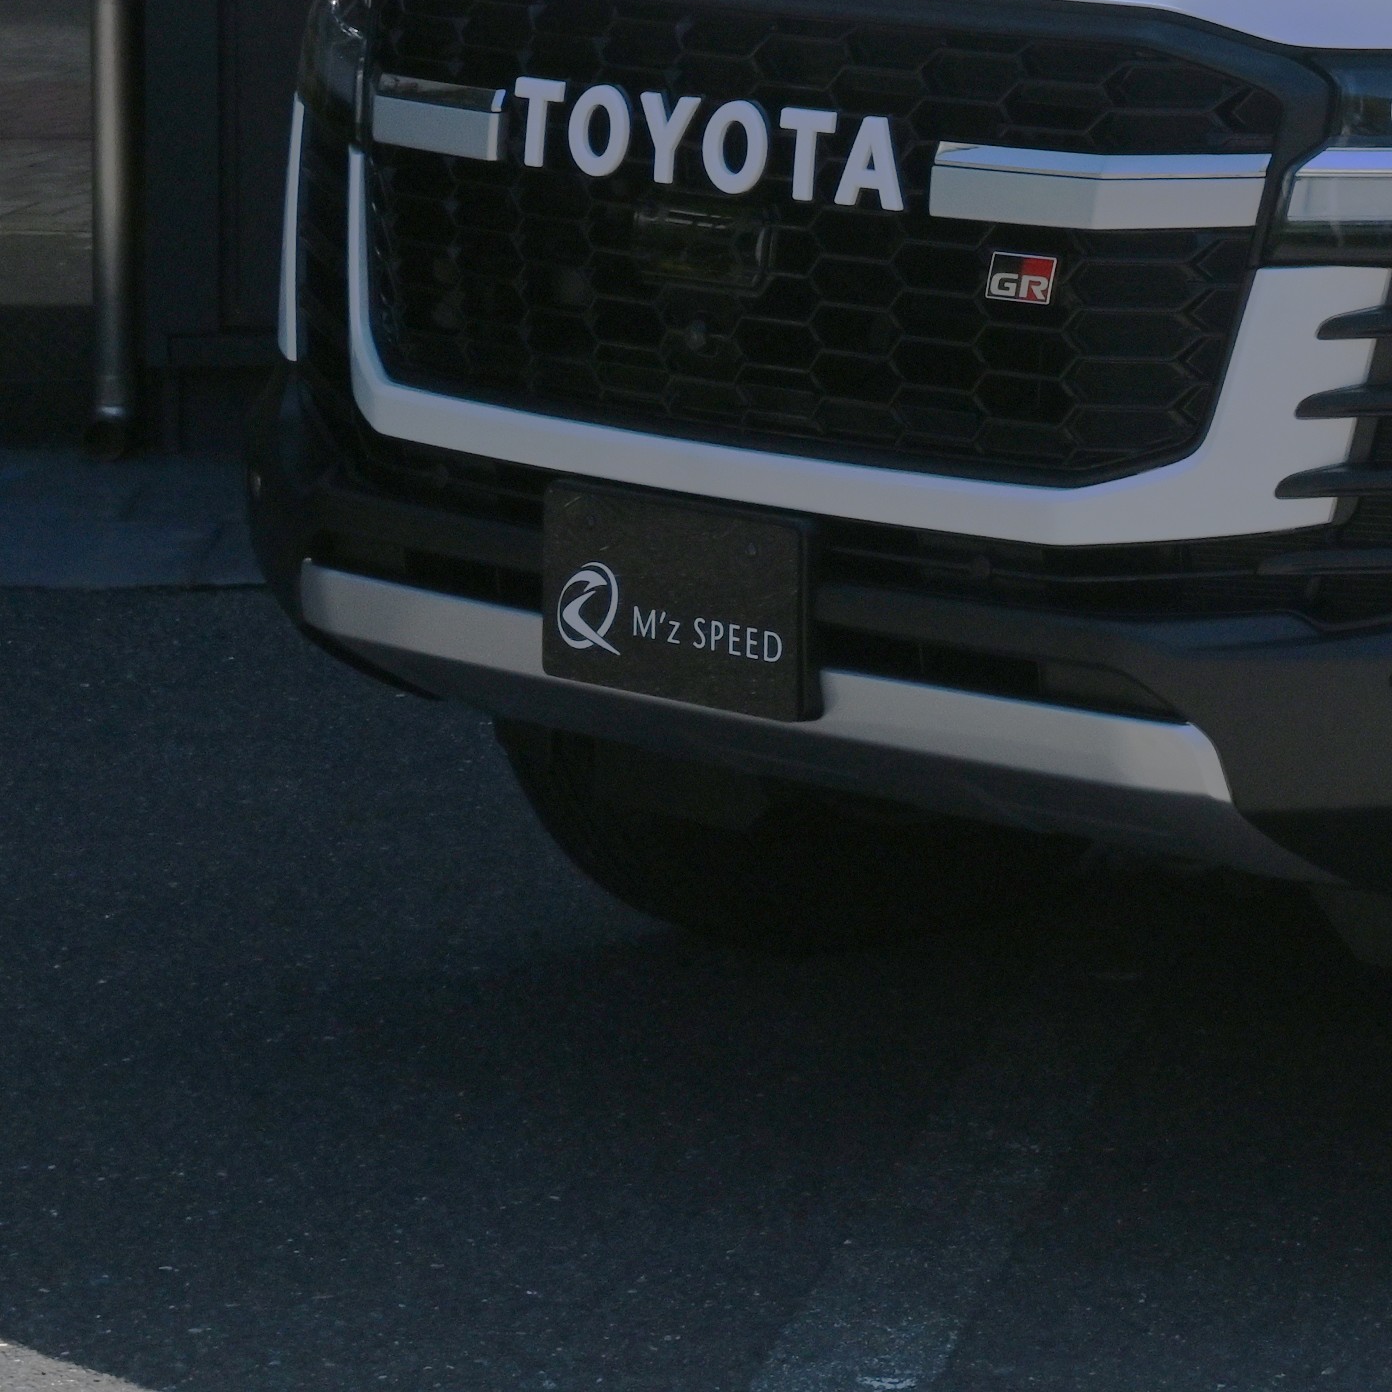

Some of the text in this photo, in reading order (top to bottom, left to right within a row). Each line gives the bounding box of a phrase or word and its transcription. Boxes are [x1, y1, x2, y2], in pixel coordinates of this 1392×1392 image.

[515, 77, 904, 211] TOYOTA
[990, 273, 1048, 300] GR
[632, 606, 783, 662] M'z SPEED
